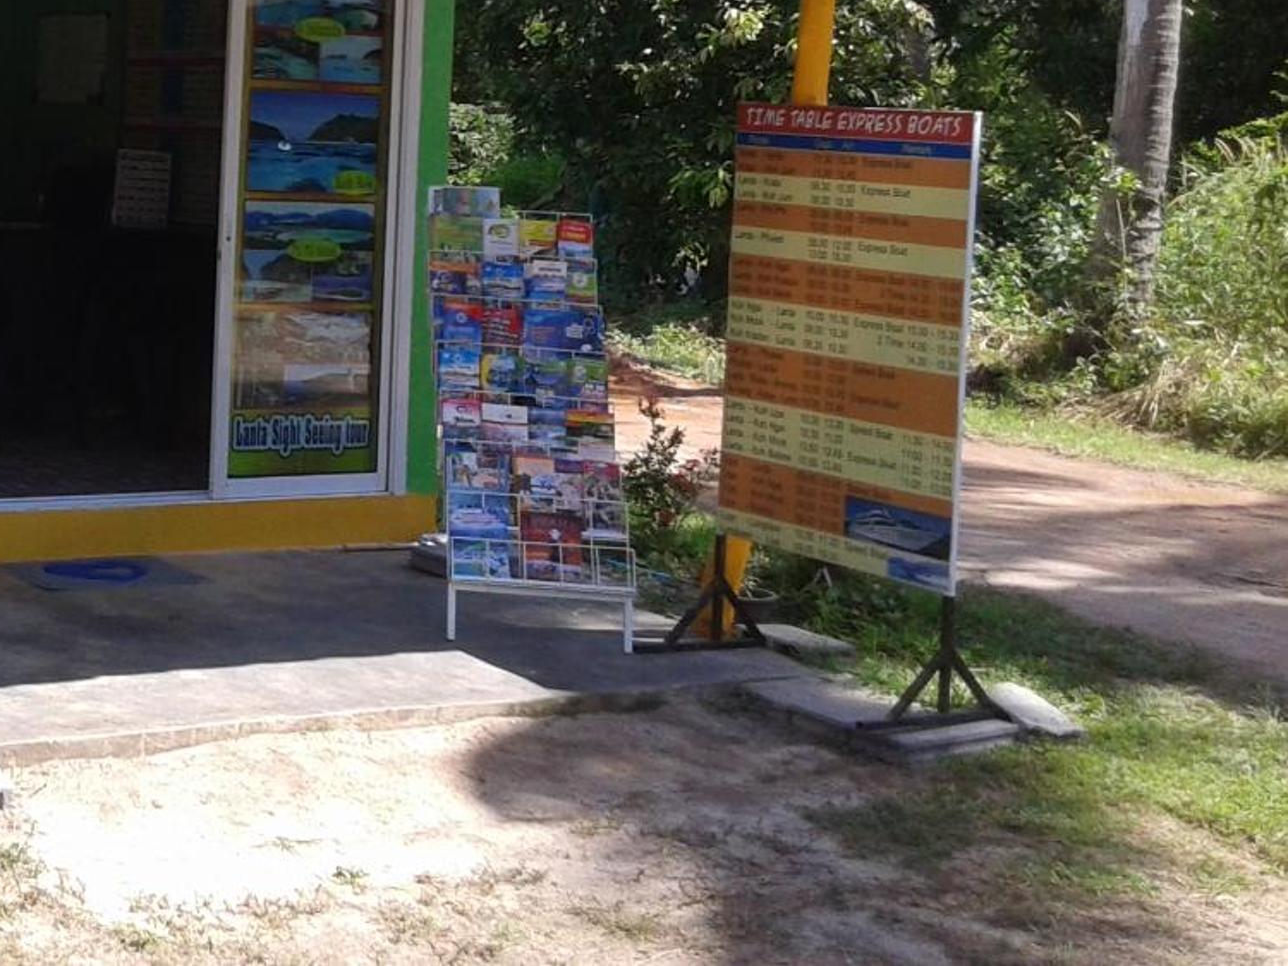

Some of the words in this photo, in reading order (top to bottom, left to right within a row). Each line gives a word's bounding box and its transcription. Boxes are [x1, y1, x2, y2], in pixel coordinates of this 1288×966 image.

[746, 107, 784, 127] TIME
[790, 110, 832, 130] TABLE
[837, 112, 902, 134] EXPRESS
[907, 115, 963, 136] BOATS
[235, 419, 268, 447] Lanta
[272, 418, 301, 453] Sight
[305, 417, 342, 451] Seeing
